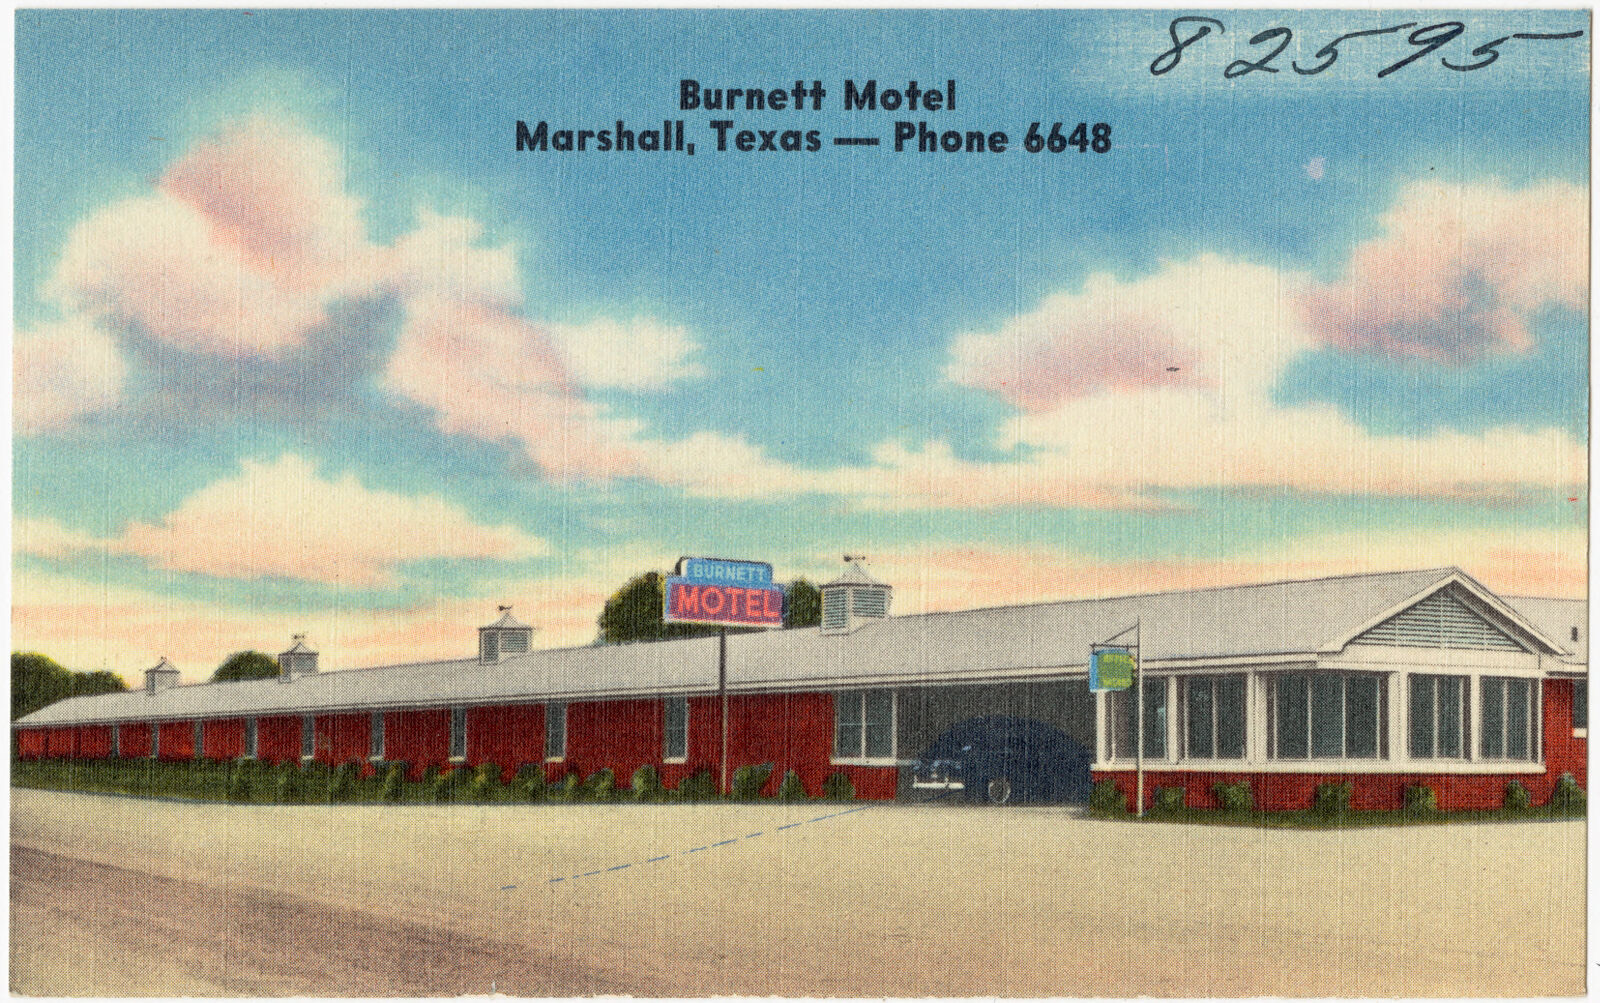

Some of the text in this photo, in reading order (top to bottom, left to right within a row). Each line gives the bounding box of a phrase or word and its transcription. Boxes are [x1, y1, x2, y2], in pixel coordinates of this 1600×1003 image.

[1150, 16, 1584, 79] 82595
[693, 563, 765, 582] BURNETT
[677, 585, 779, 618] MOTEL
